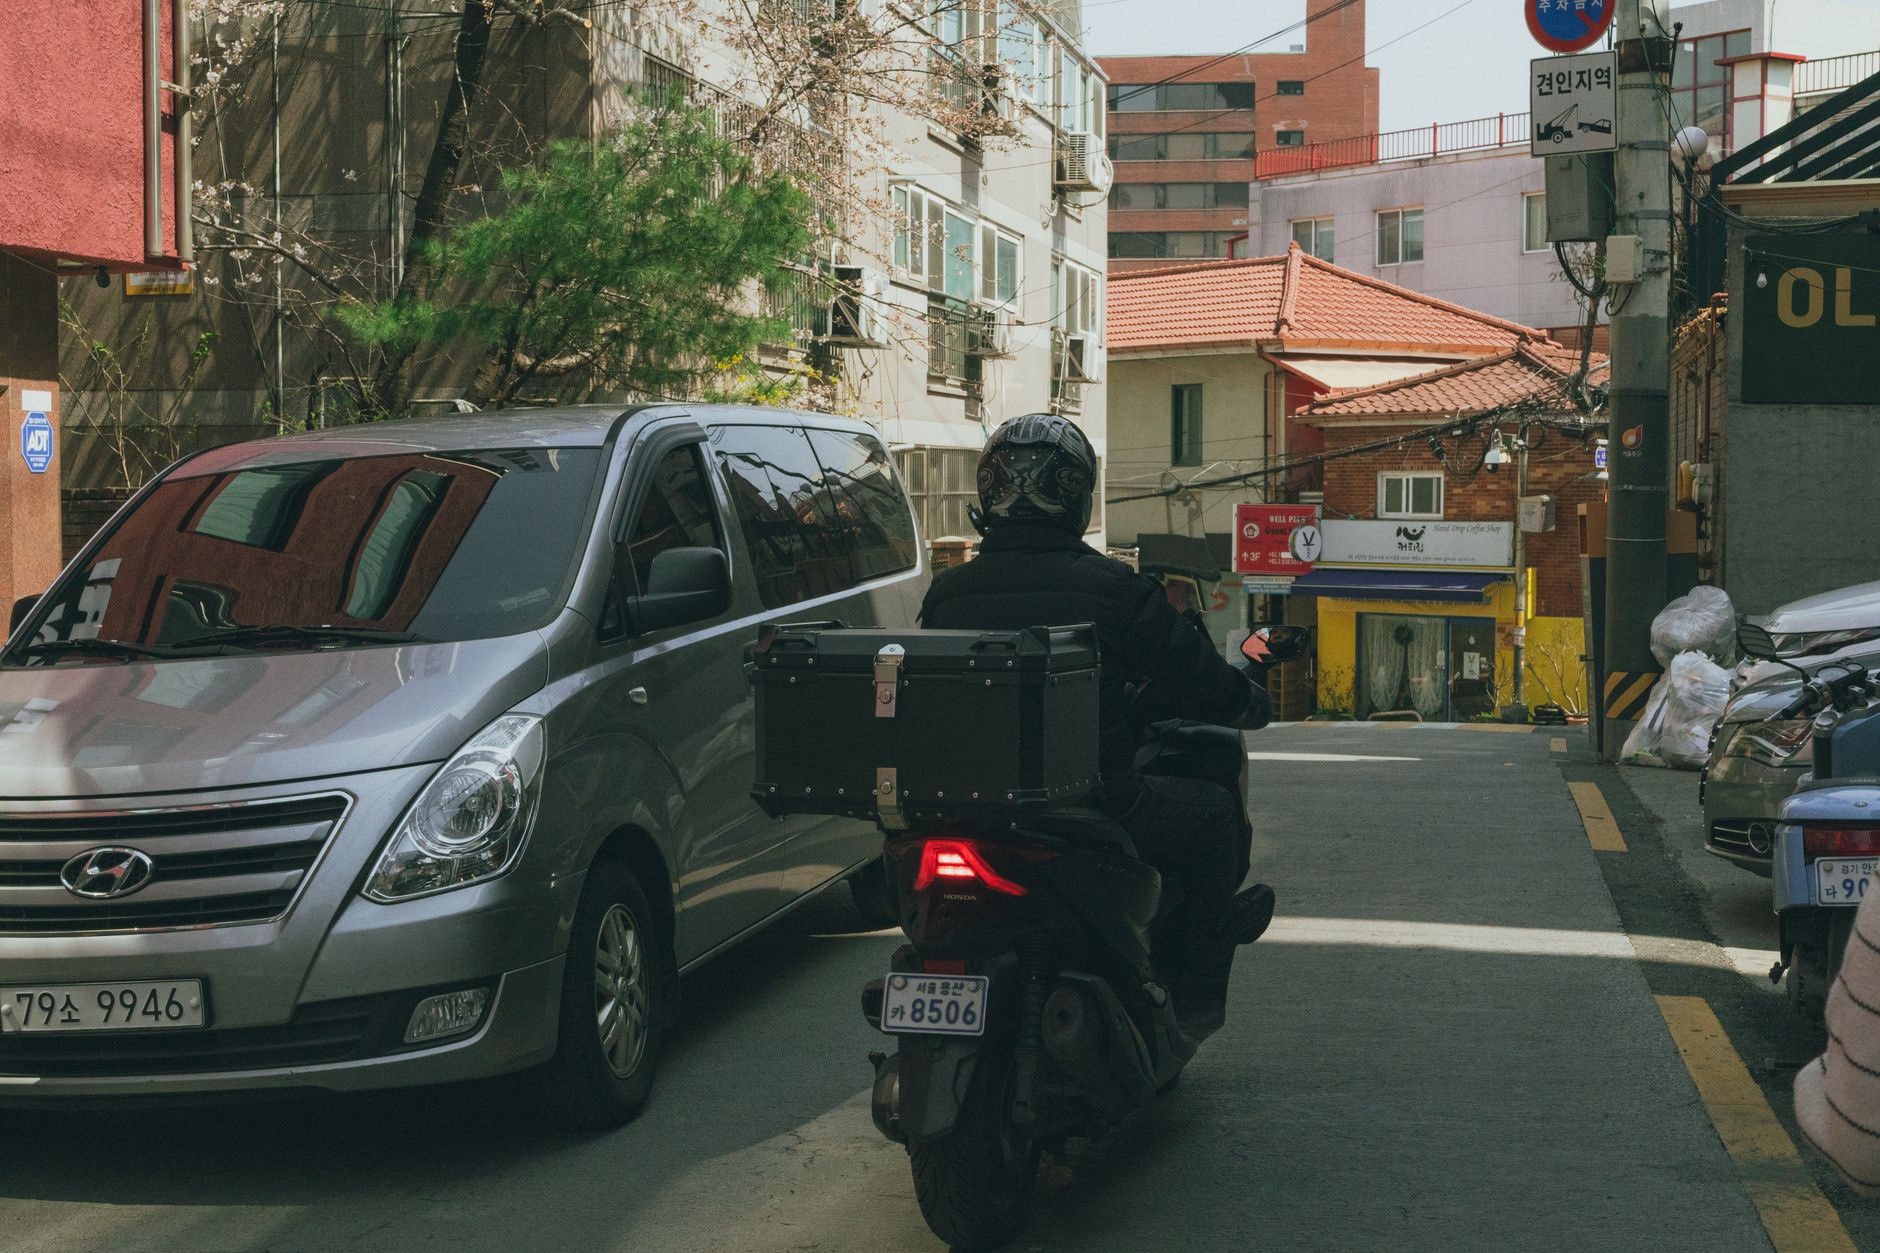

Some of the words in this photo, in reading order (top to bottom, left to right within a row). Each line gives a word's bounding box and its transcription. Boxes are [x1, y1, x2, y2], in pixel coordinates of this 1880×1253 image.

[1536, 66, 1611, 96] 견인지역
[1777, 267, 1877, 328] OL
[27, 429, 48, 452] ADT
[1452, 525, 1465, 533] Drip
[1466, 524, 1485, 534] Coffee
[1486, 524, 1501, 534] Shop
[1250, 552, 1260, 560] 3F
[1841, 864, 1858, 875] 경기
[943, 893, 977, 901] HONDA
[1824, 885, 1837, 899] 다
[1842, 878, 1869, 898] 90
[916, 982, 937, 995] 서울
[940, 982, 964, 997] 용산
[16, 991, 81, 1026] 79소
[96, 987, 184, 1024] 9946
[891, 1005, 906, 1021] 카
[911, 998, 977, 1026] 8506
